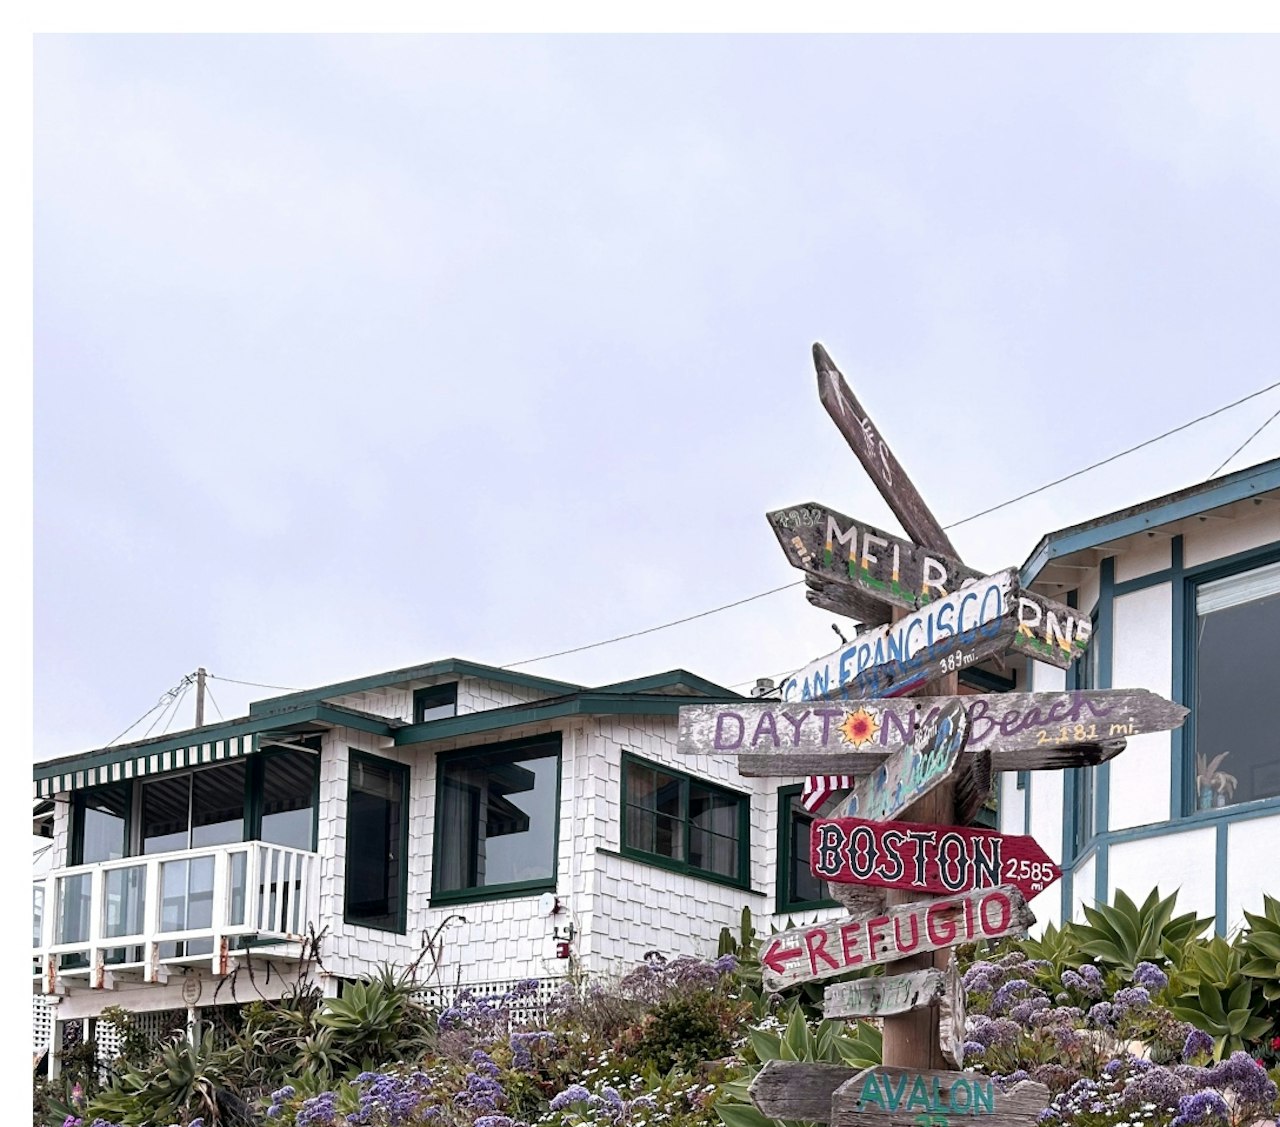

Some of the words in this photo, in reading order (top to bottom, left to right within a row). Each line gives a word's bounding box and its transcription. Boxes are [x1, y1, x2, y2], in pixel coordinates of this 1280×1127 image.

[839, 584, 1001, 702] FRANCISCO
[967, 690, 1116, 746] Beach
[816, 823, 1003, 891] BOSTON
[1005, 857, 1054, 882] 2,585
[804, 892, 1012, 976] REFUGIO
[856, 1072, 995, 1116] AVALON
